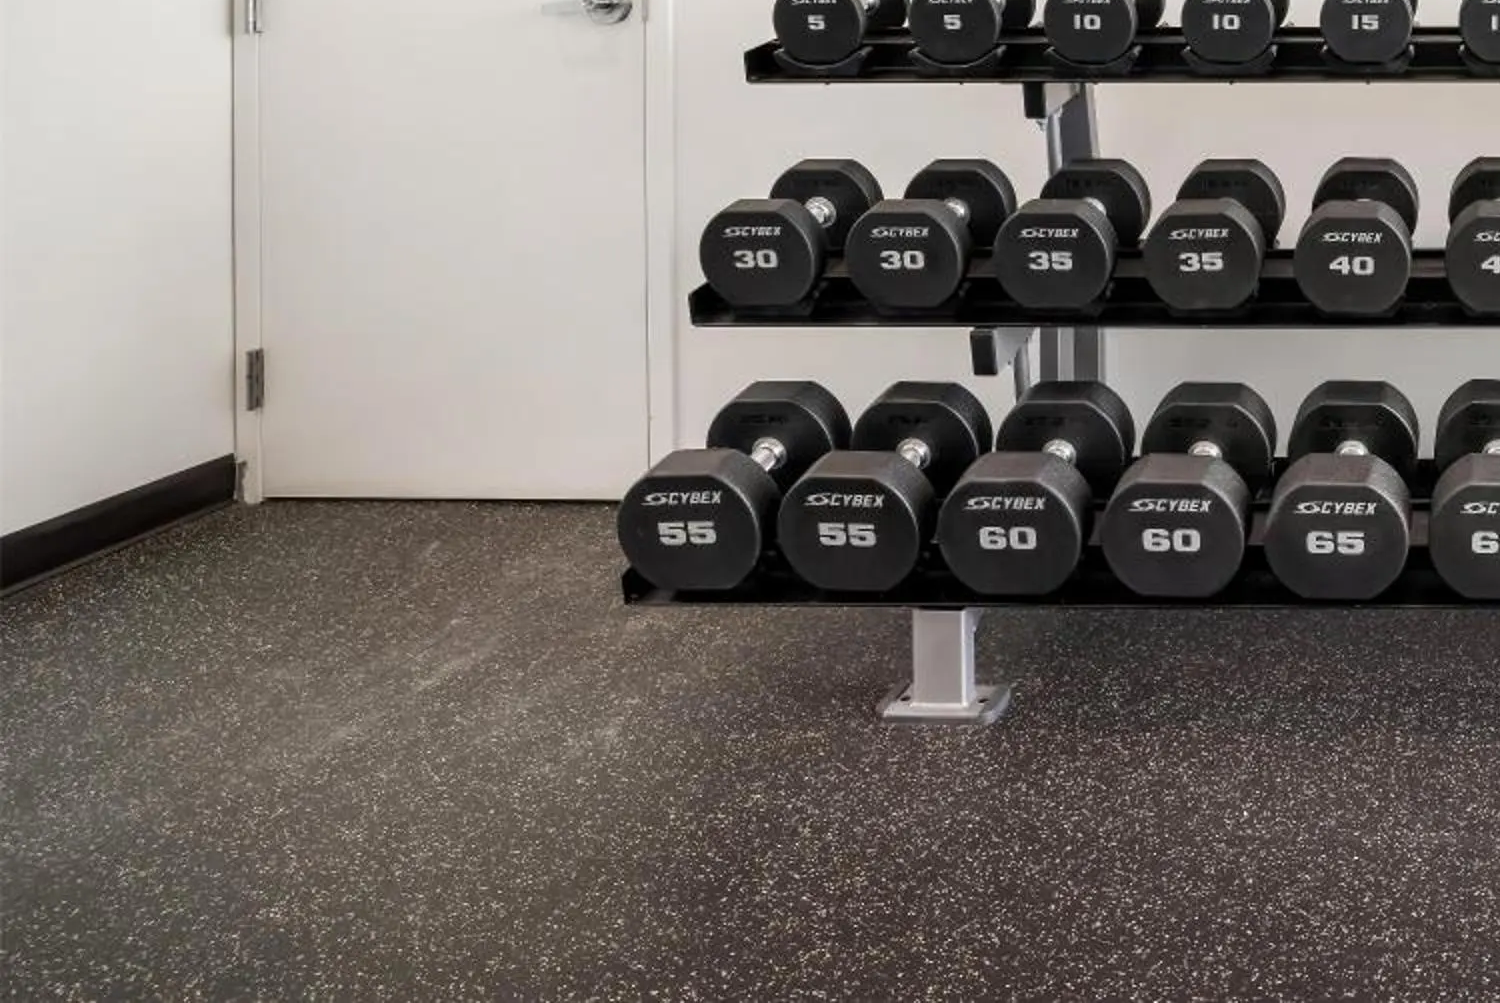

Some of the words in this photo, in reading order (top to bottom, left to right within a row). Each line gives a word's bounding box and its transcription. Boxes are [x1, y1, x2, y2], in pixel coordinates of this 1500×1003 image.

[807, 15, 825, 30] 5
[943, 14, 961, 30] 5
[1074, 14, 1101, 30] 10
[1213, 14, 1240, 30] 10
[1351, 14, 1379, 30] 15
[742, 226, 781, 238] CYBEX
[889, 226, 929, 238] CYBEX
[1039, 228, 1079, 238] CYBEX
[1188, 228, 1229, 240] CYBEX
[1341, 232, 1383, 244] CYBEX
[733, 249, 778, 268] 30
[880, 250, 925, 270] 30
[1028, 251, 1073, 270] 35
[1179, 252, 1224, 272] 35
[1329, 256, 1375, 275] 40
[668, 490, 722, 506] CYBEX
[830, 492, 885, 508] CYBEX
[991, 496, 1046, 510] CYBEX
[1155, 498, 1212, 513] CYBEX
[1321, 500, 1377, 515] CYBEX
[657, 521, 717, 546] 55
[818, 522, 876, 547] 55
[979, 526, 1037, 550] 60
[1142, 528, 1201, 552] 60
[1306, 531, 1365, 554] 65
